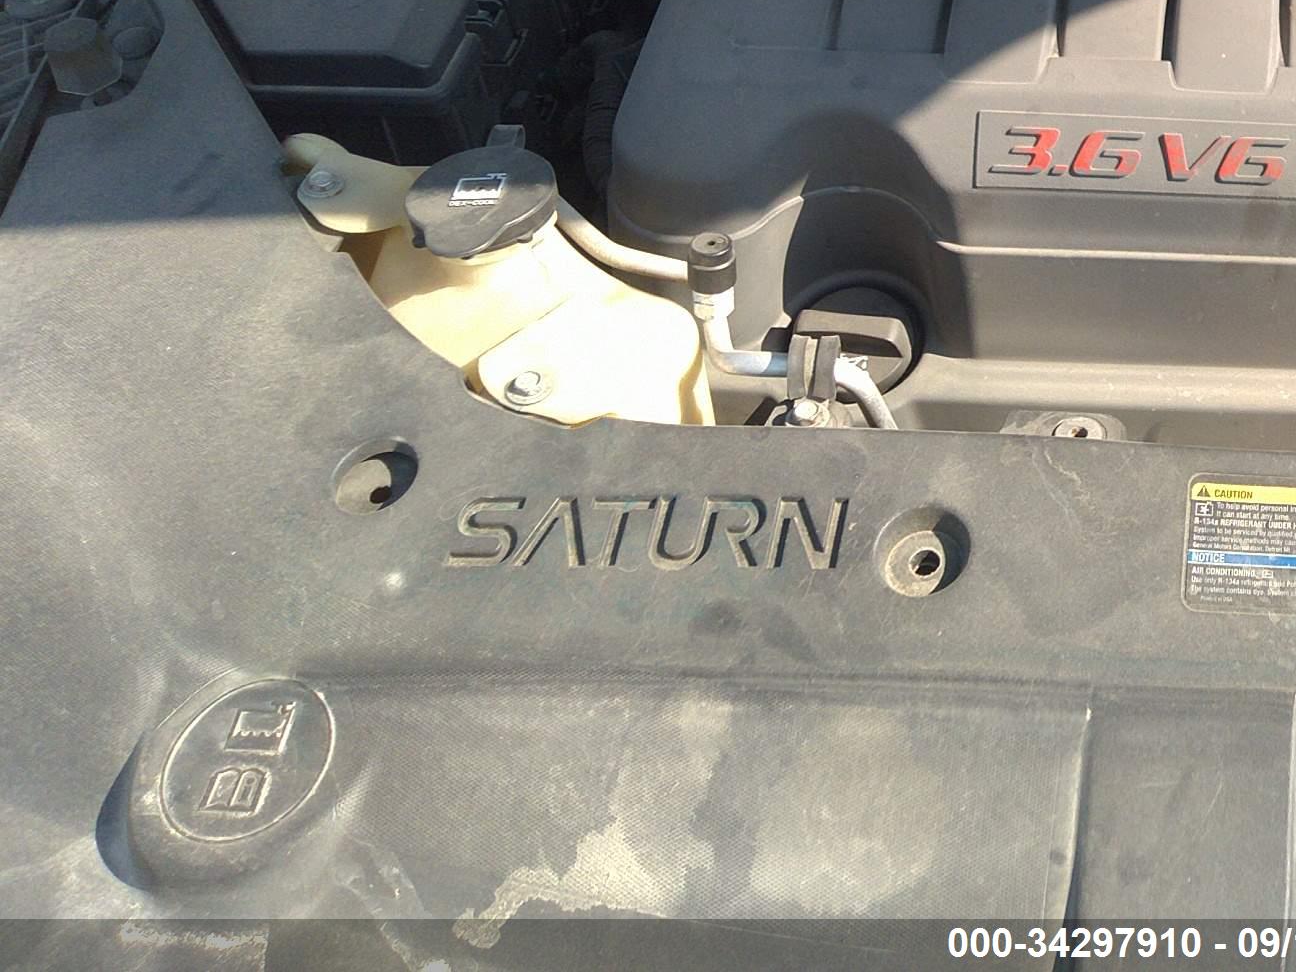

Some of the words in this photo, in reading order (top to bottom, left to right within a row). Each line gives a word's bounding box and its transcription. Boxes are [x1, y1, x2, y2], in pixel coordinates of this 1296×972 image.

[988, 126, 1146, 180] 3.6
[1158, 132, 1291, 186] V6
[1213, 489, 1253, 499] CAUTION
[1220, 518, 1266, 528] REFRIGERANT
[1268, 521, 1292, 529] UNDER
[442, 495, 850, 572] SATURN
[1191, 551, 1225, 563] NOTICE
